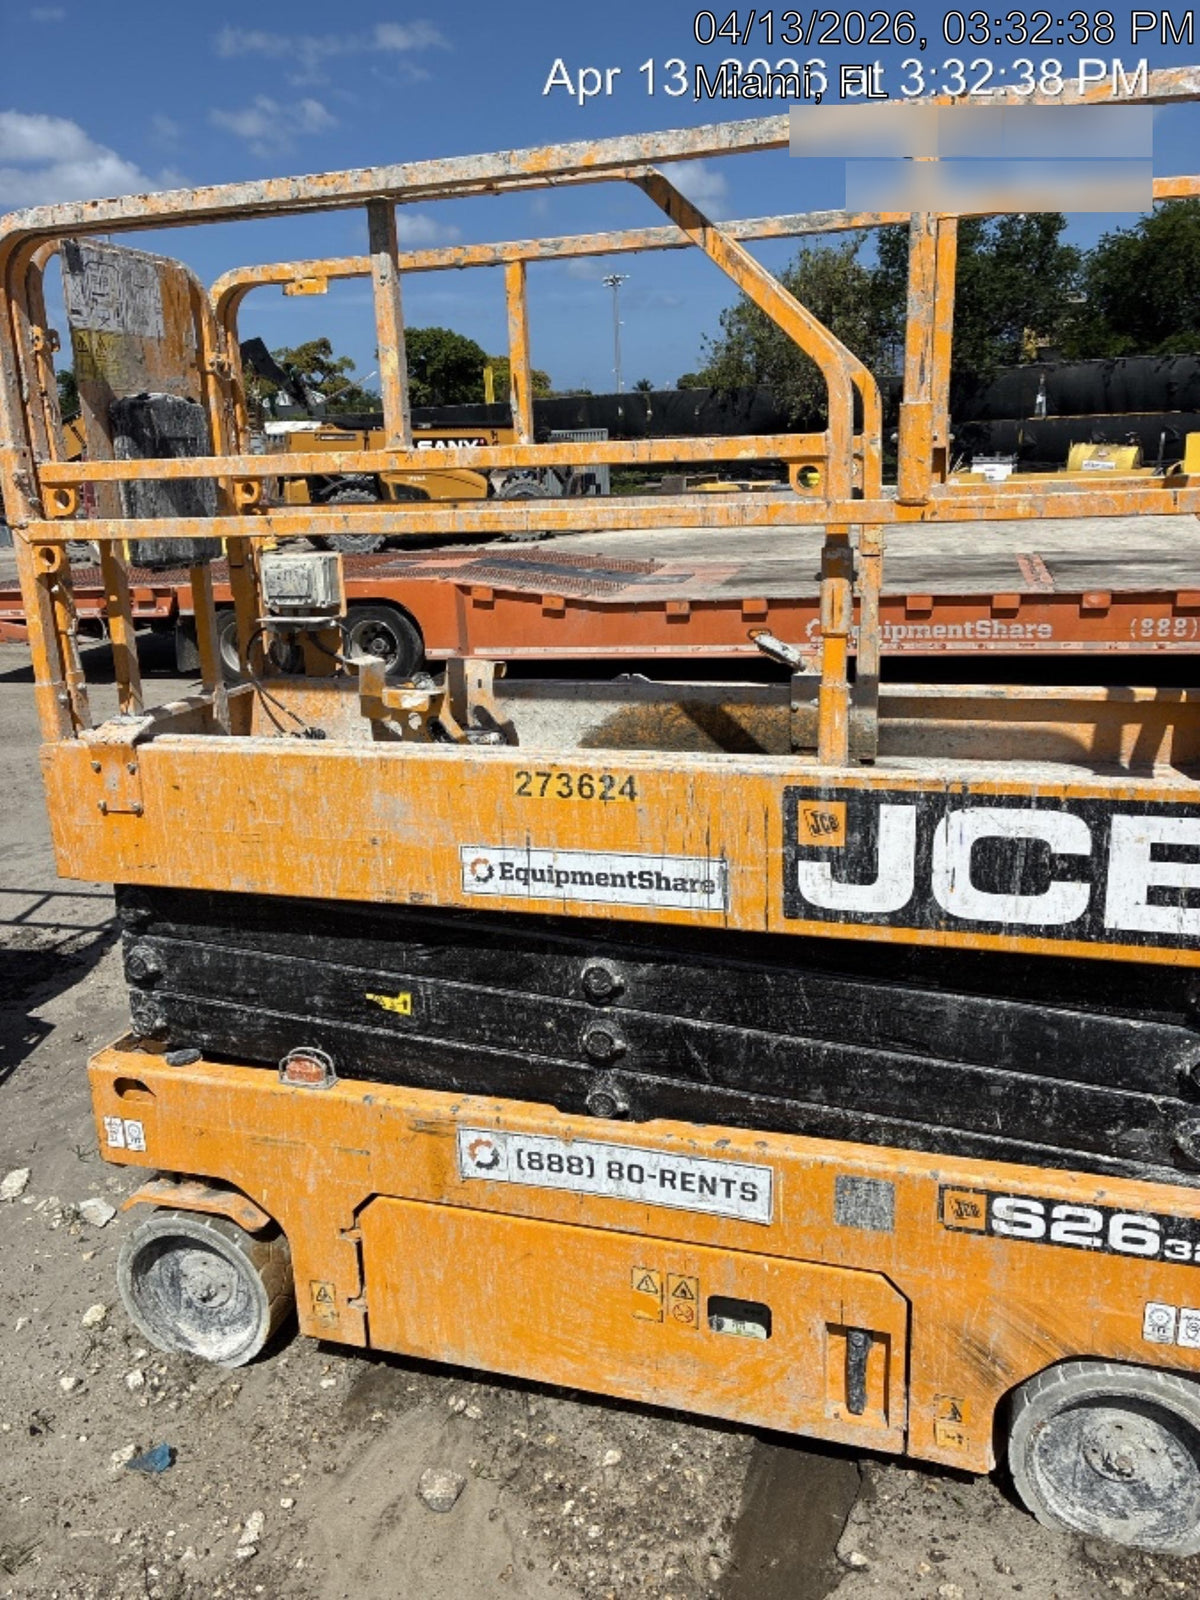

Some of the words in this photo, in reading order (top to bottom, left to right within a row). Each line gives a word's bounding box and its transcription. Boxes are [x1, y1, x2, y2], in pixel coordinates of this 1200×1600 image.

[849, 618, 1053, 642] ipmentShare
[1130, 617, 1198, 639] (888)
[515, 771, 638, 801] 273624
[499, 862, 716, 895] EquipmentShare
[515, 1148, 595, 1178] (888)
[607, 1160, 759, 1202] 80-RENTS
[991, 1197, 1200, 1263] S263
